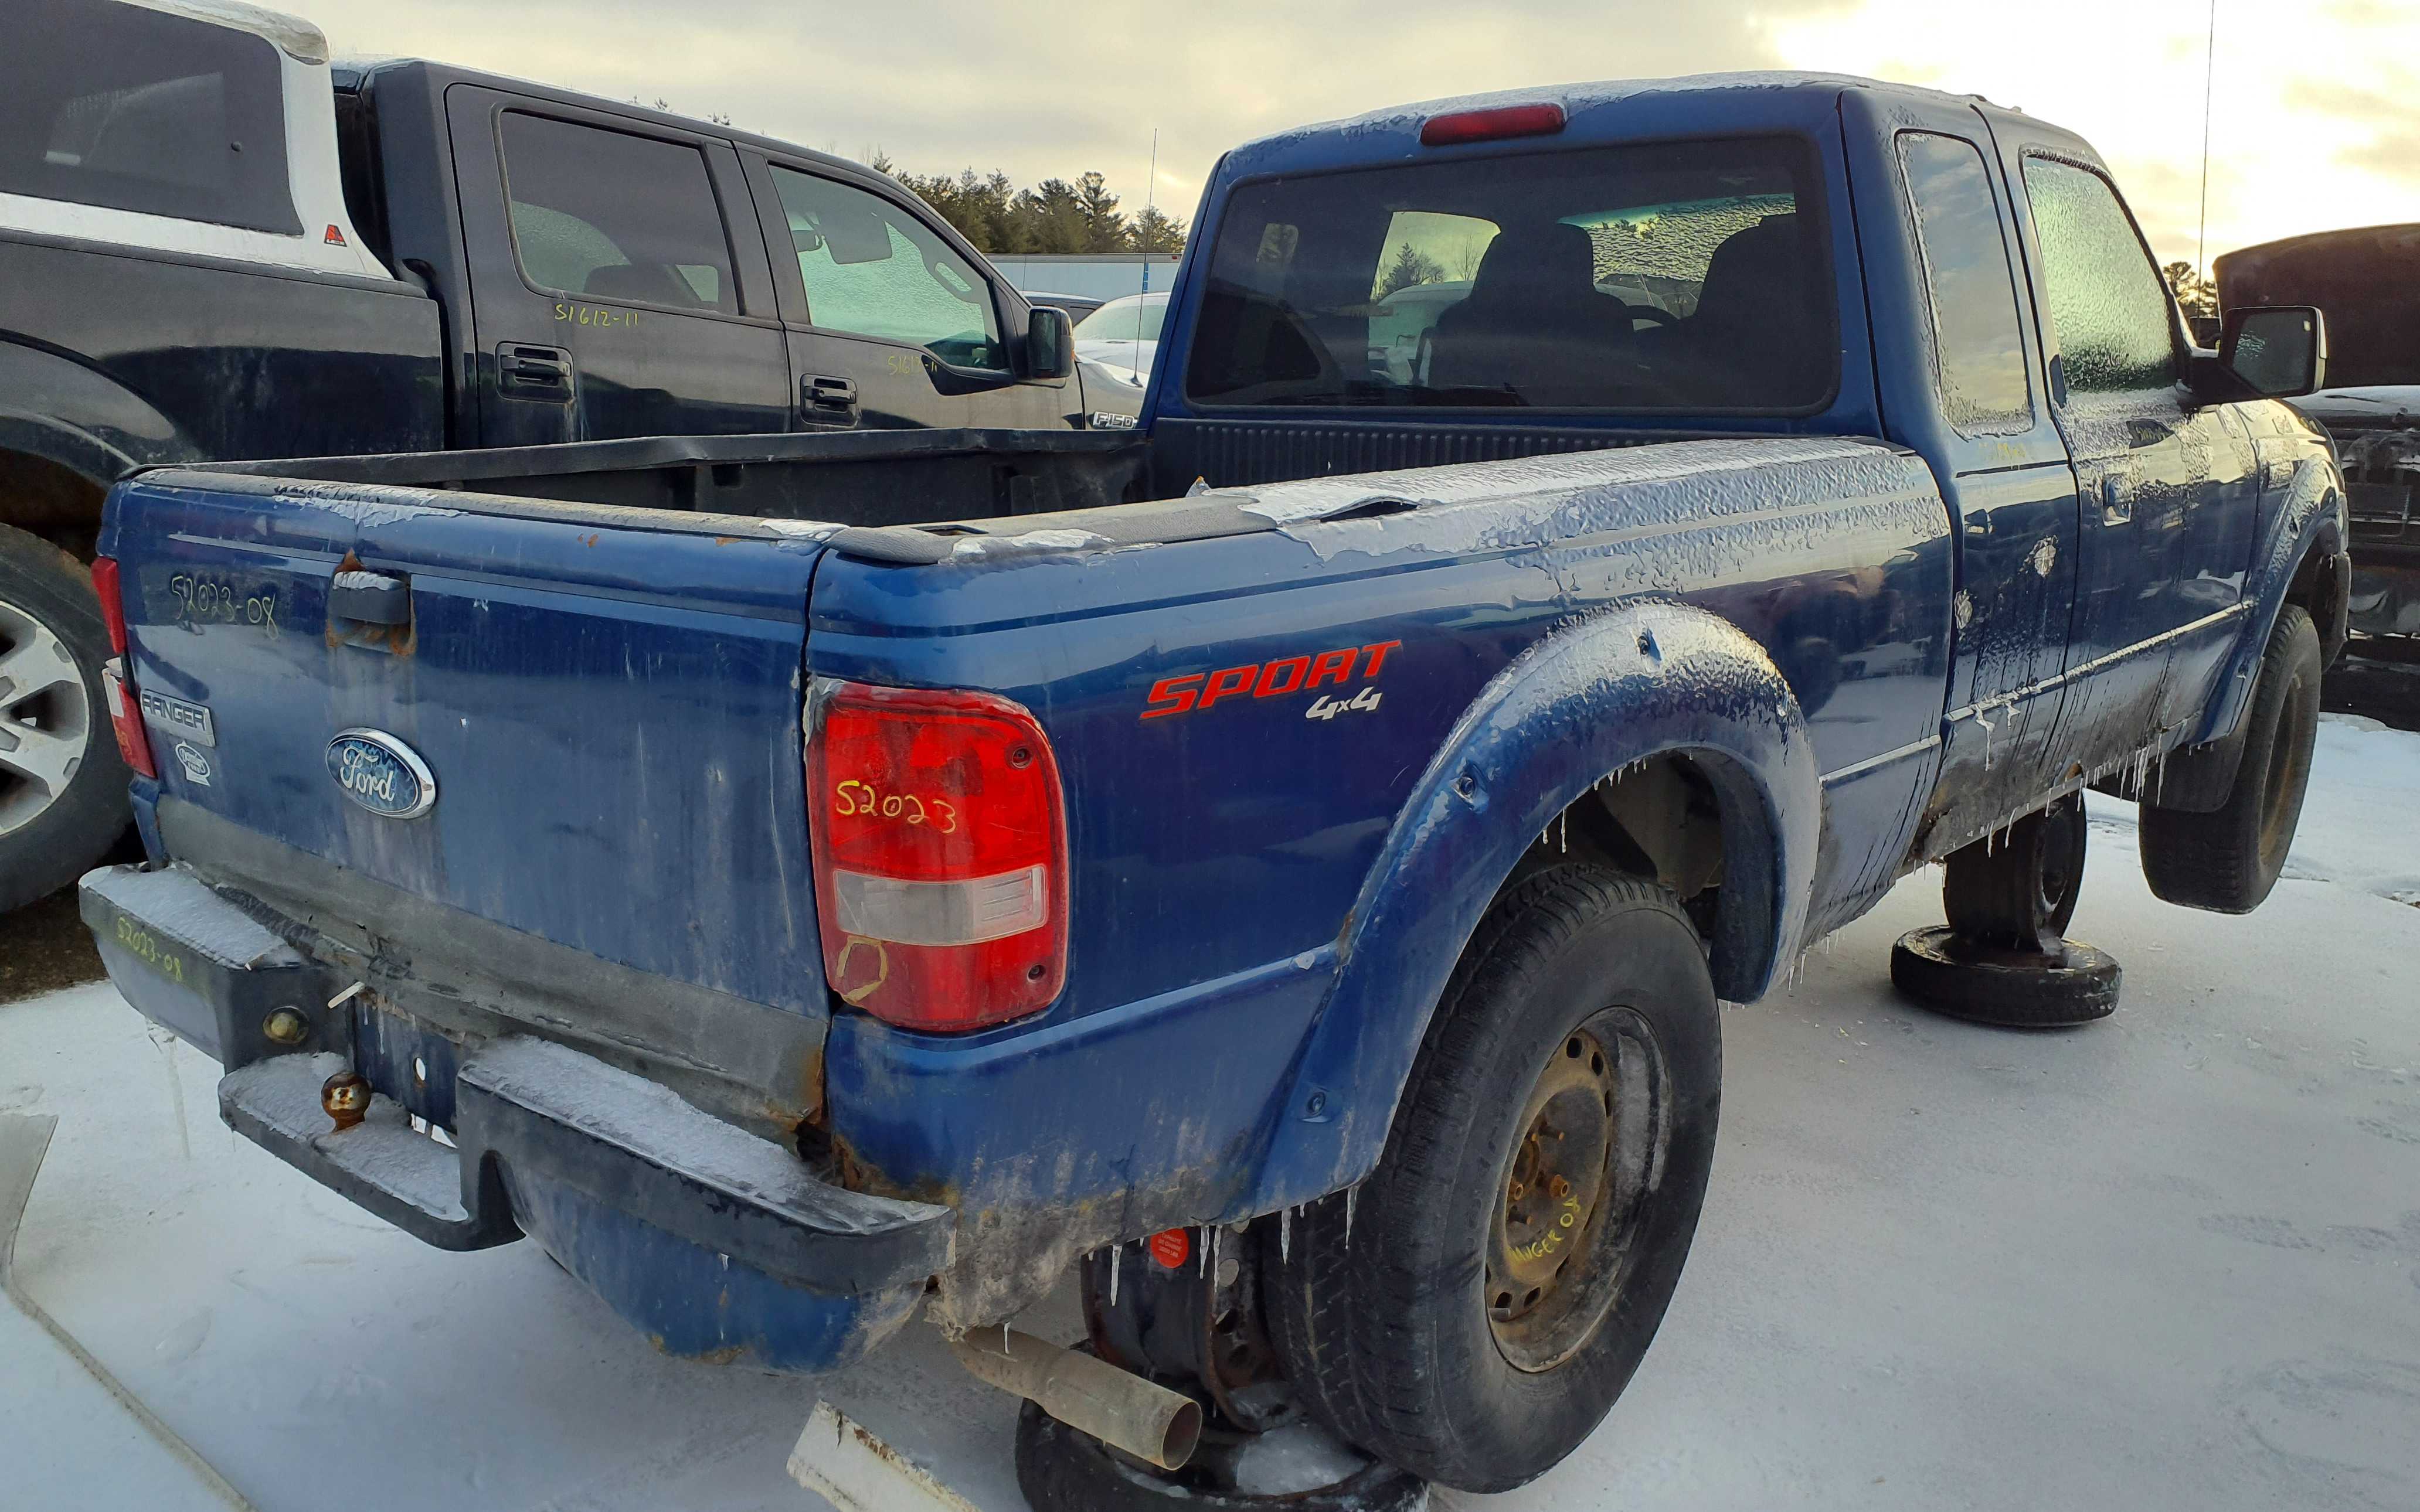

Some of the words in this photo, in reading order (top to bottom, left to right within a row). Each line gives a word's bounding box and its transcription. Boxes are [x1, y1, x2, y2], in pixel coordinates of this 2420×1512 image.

[1140, 639, 1402, 720] SPORT
[1305, 686, 1382, 720] 4x4
[141, 693, 206, 731] RANGER
[340, 744, 395, 802] Ford
